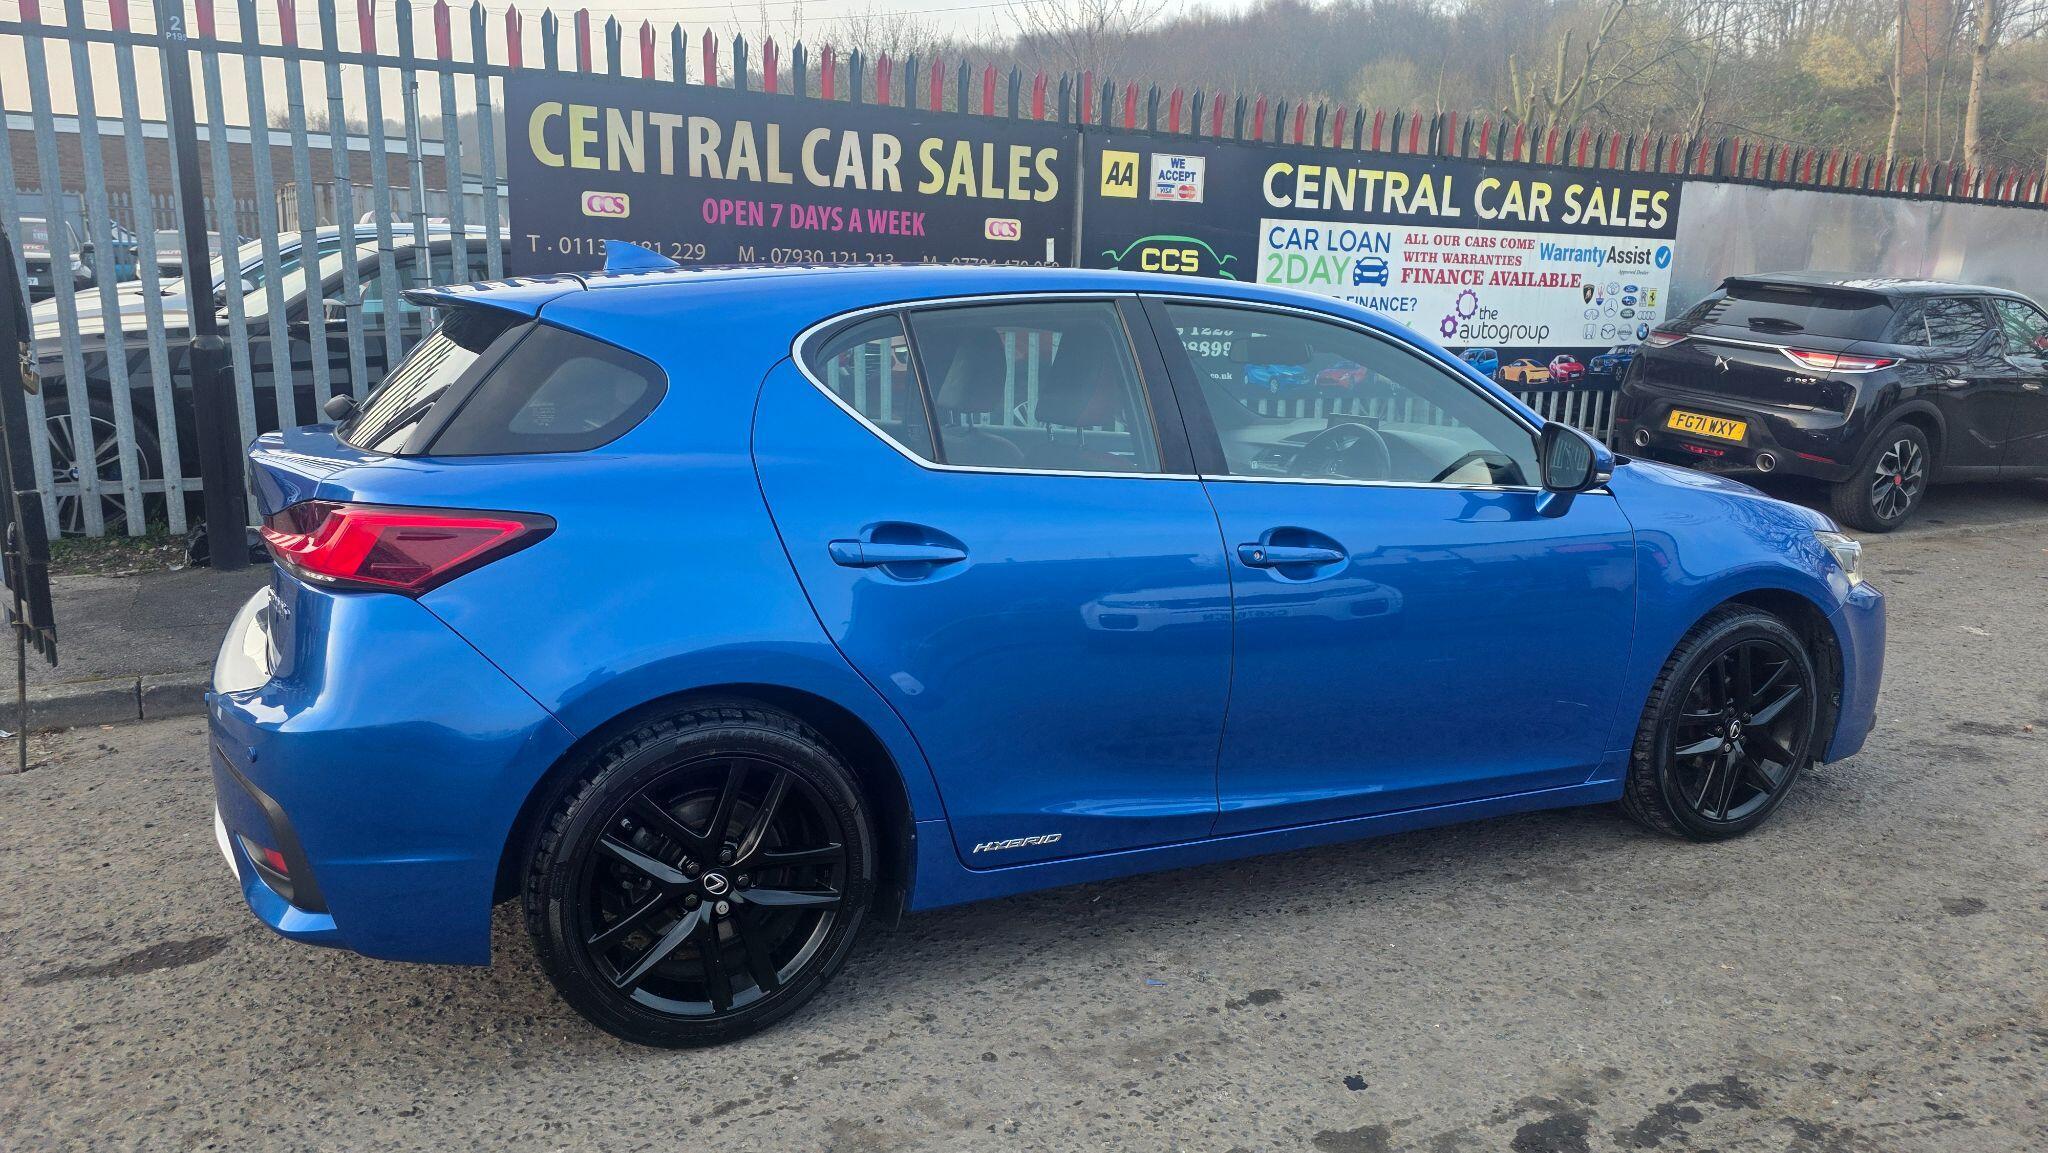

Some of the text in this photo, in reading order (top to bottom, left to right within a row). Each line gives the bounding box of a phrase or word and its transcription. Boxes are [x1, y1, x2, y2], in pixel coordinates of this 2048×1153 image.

[170, 15, 181, 30] 2
[528, 101, 1059, 202] CENTRAL CAR SALES
[1105, 161, 1133, 186] AA
[1171, 157, 1186, 169] WE
[1158, 170, 1196, 182] ACCEPT
[587, 195, 625, 214] CCS
[1263, 162, 1670, 230] CENTRAL CAR SALES
[702, 197, 926, 237] OPEN 7 DAYS A WEEK
[988, 220, 1018, 239] CCS
[1268, 226, 1392, 253] CAR LOAN
[558, 236, 608, 256] 0113
[671, 242, 706, 260] 229
[1404, 233, 1536, 250] ALL OUR CARS COME
[770, 247, 824, 263] 07930
[1141, 247, 1199, 272] CCS
[1403, 251, 1522, 267] WITH WARRANTIES
[1265, 252, 1352, 285] 2DAY
[1401, 267, 1582, 288] FINANCE AVAILABLE
[1479, 306, 1498, 320] the
[1459, 320, 1550, 344] autogroup
[1675, 413, 1737, 437] FG71 WXY
[972, 833, 1062, 853] HYBRID
